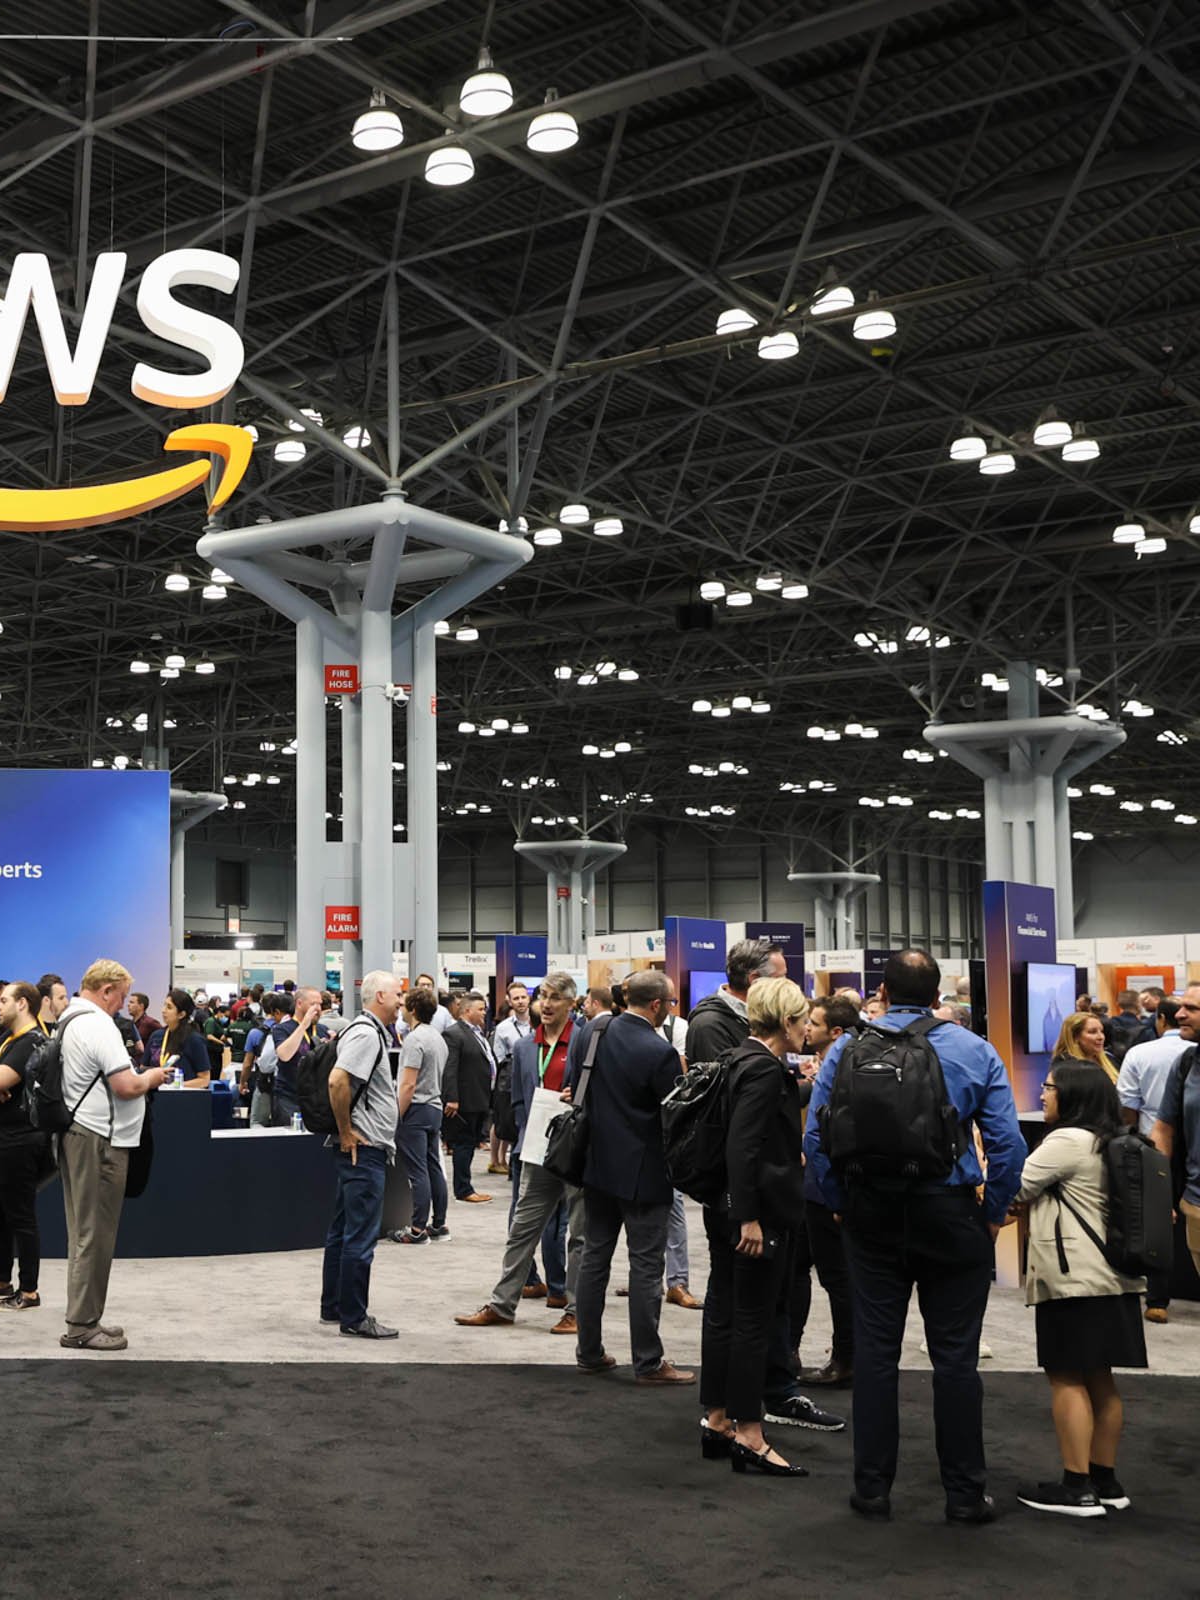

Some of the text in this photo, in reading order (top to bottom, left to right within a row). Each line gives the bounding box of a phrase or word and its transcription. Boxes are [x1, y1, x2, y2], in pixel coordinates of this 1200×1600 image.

[332, 669, 350, 678] FIRE
[329, 680, 353, 688] HOSE
[333, 914, 352, 922] FIRE
[327, 924, 358, 932] ALARM
